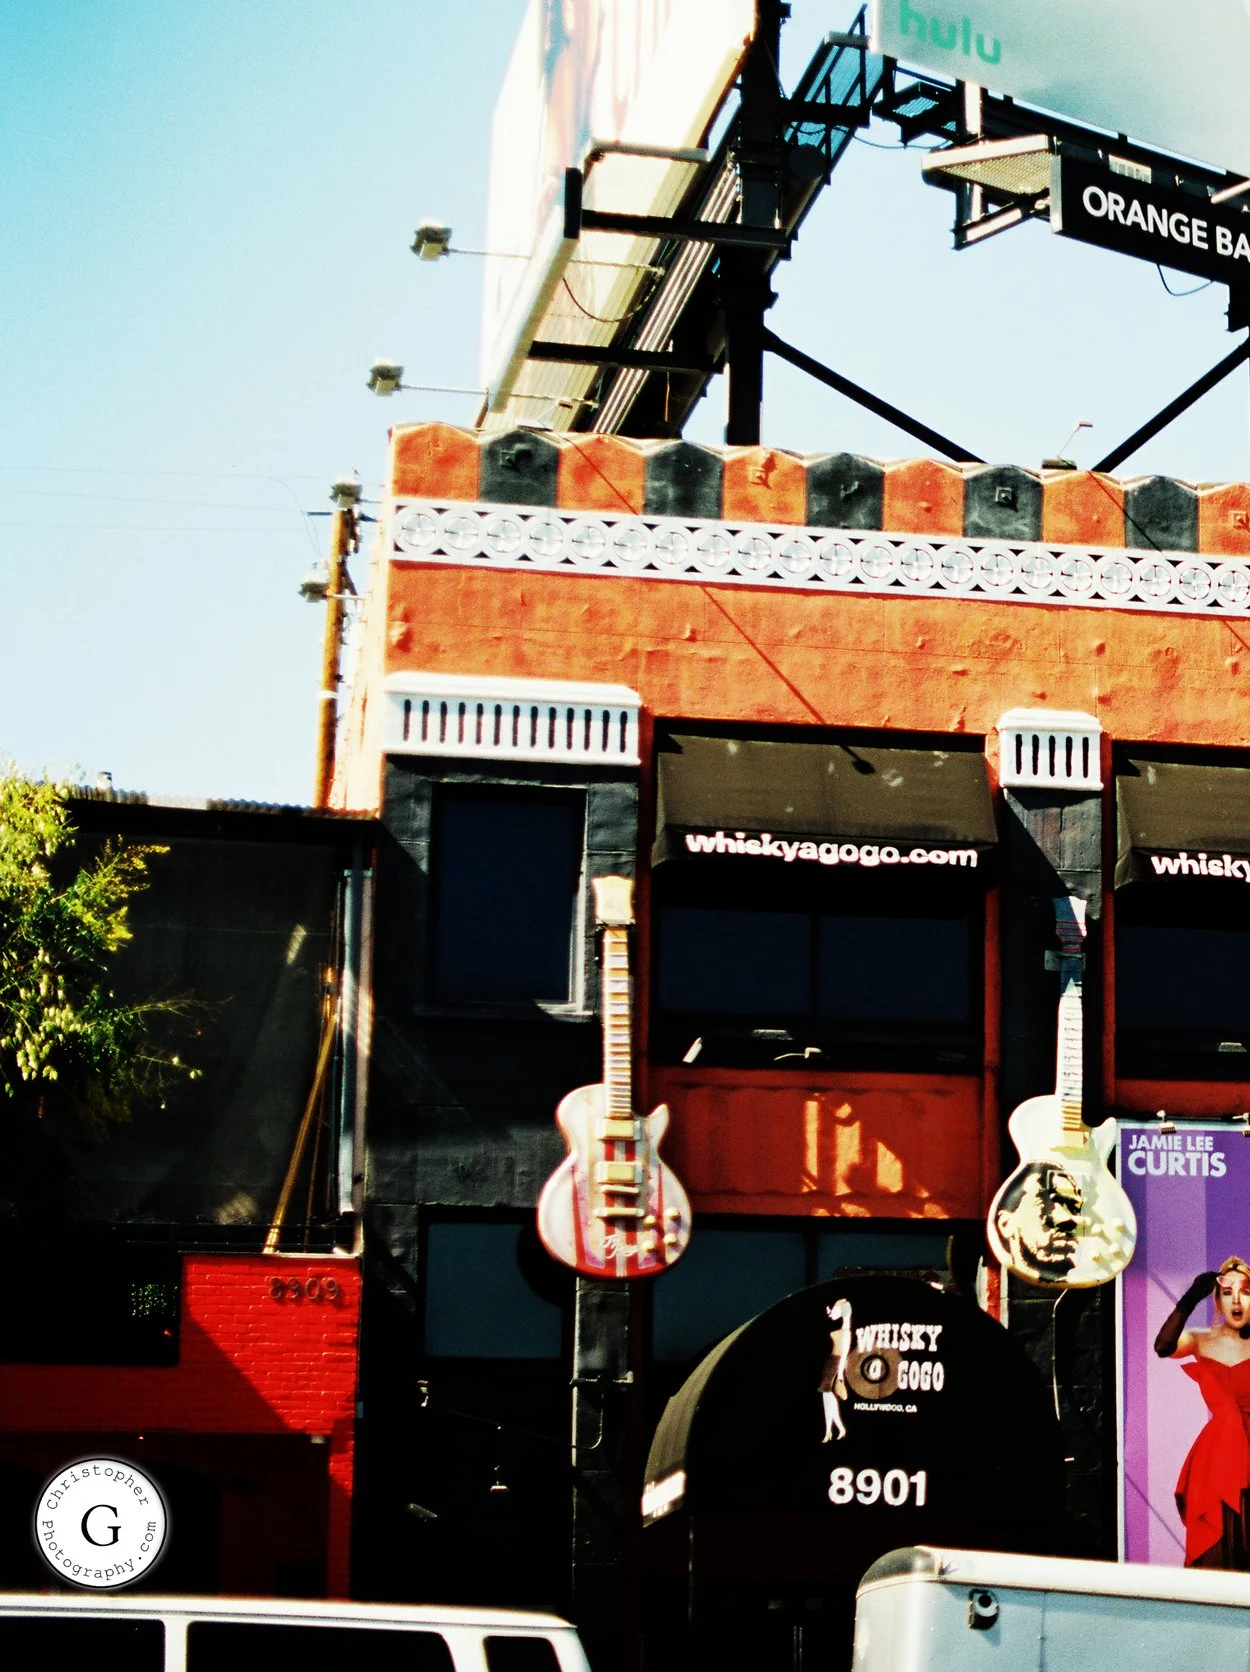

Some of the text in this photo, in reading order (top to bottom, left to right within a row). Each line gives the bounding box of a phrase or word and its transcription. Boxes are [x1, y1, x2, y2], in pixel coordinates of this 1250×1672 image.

[899, 0, 1000, 64] hulu
[1082, 185, 1209, 250] ORANGE
[685, 831, 978, 868] whiskyagogo.com
[1129, 1134, 1213, 1151] JAMIE LEE
[1127, 1151, 1227, 1177] CURTIS
[268, 1275, 338, 1300] 8909
[855, 1323, 944, 1353] WHISKY
[897, 1361, 945, 1391] GOGO
[905, 1404, 918, 1413] CA
[828, 1467, 928, 1507] 8901
